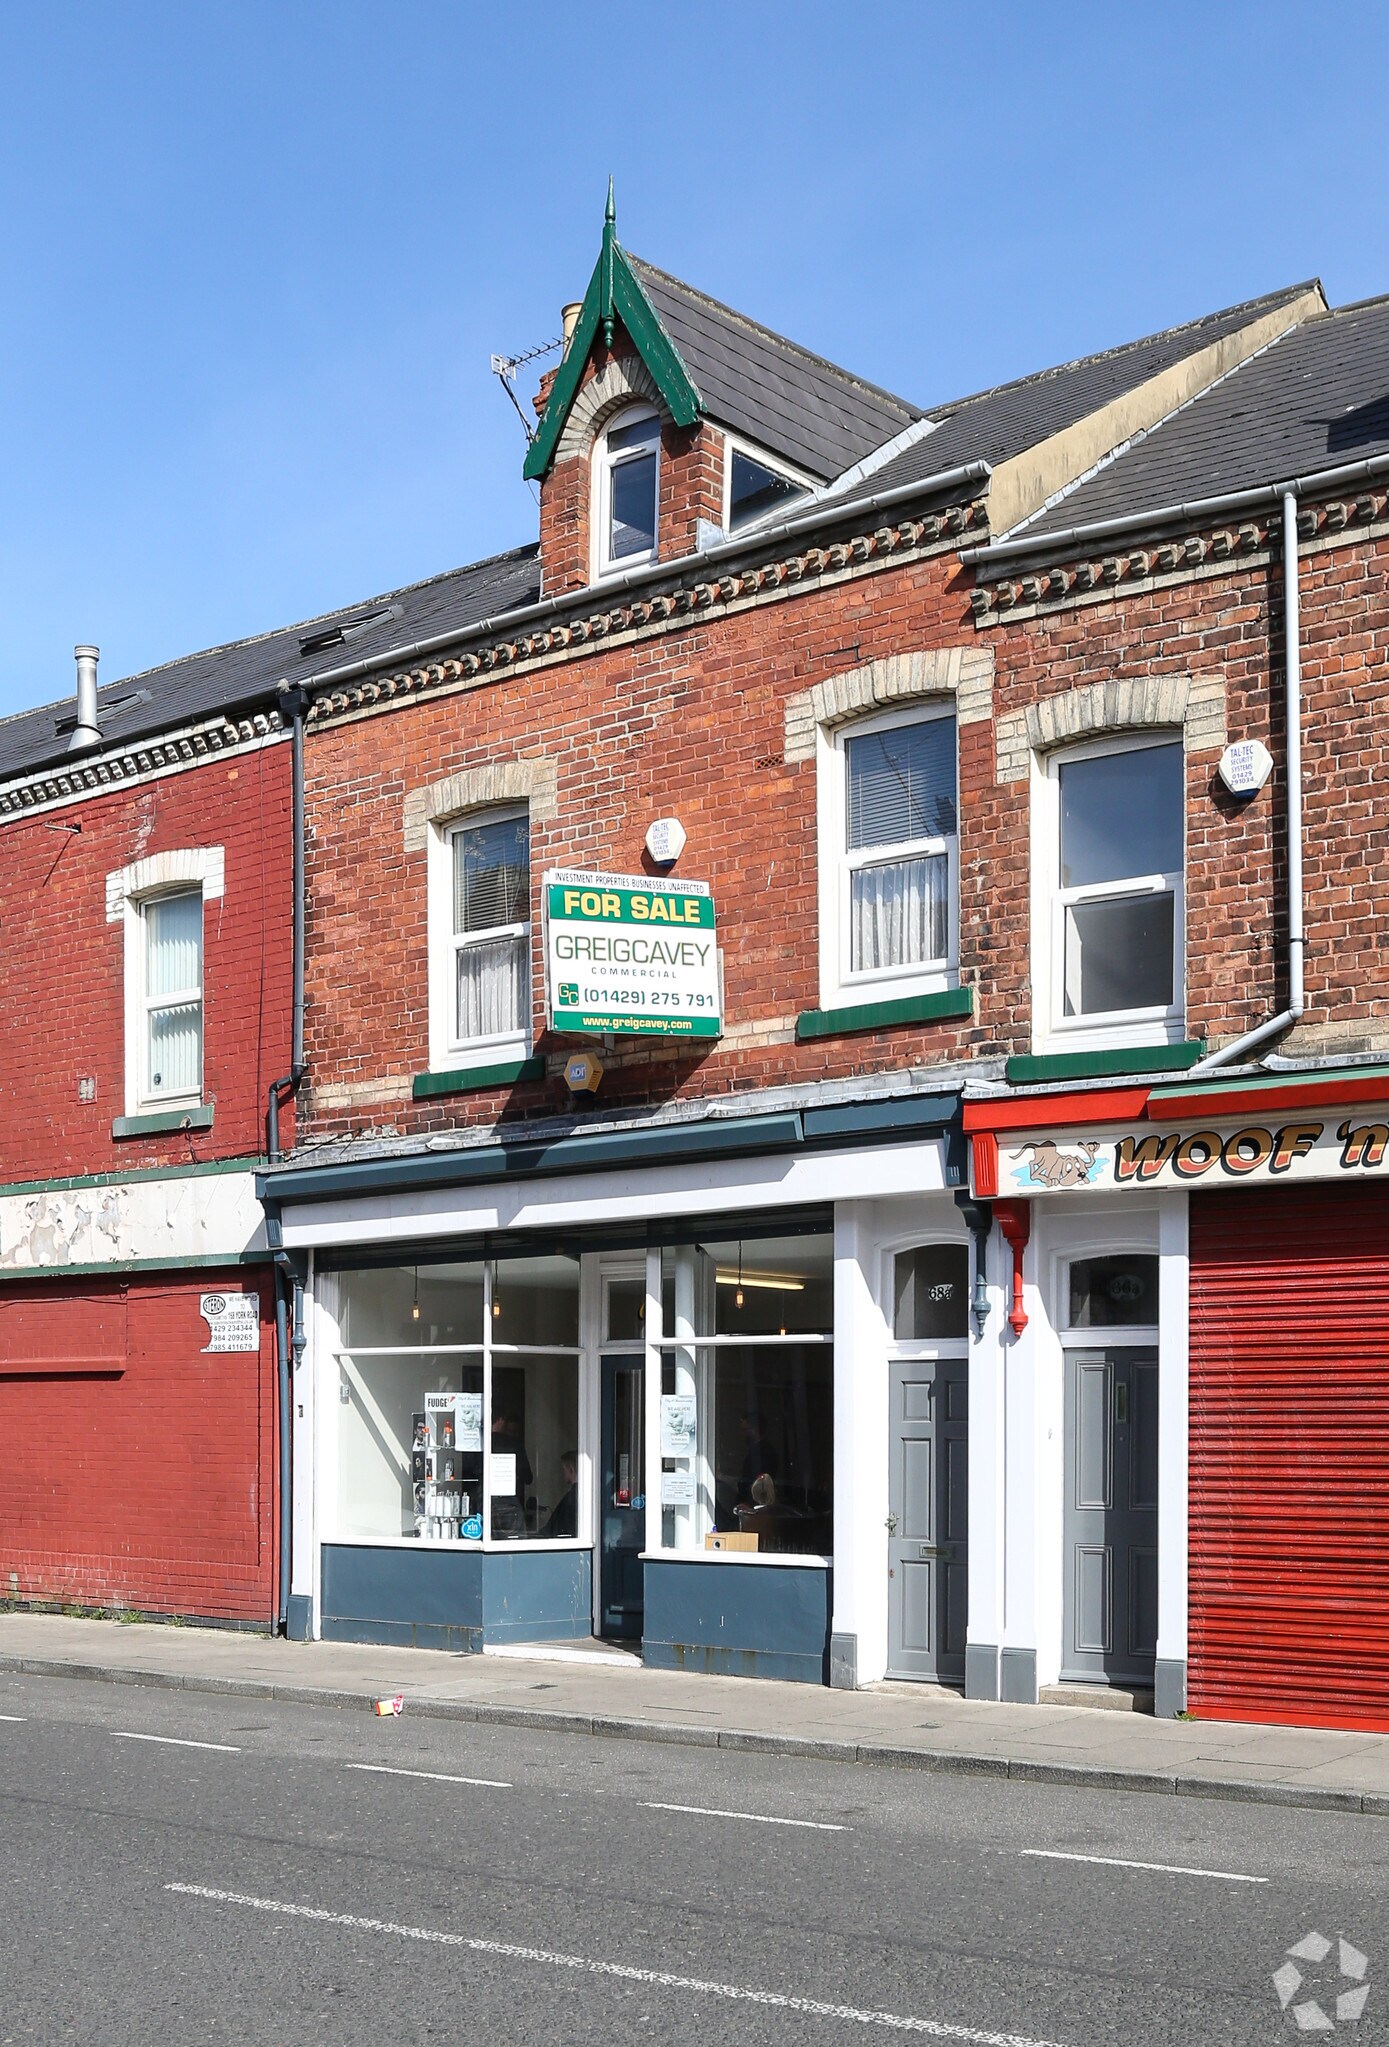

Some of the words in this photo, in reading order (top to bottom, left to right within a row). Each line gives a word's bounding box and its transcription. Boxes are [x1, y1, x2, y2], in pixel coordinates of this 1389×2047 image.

[1230, 756, 1253, 766] SECURITY
[1231, 764, 1253, 773] SYSTEMS
[1232, 771, 1252, 780] 01429
[555, 872, 594, 884] INVESTMENT
[596, 875, 630, 887] PROPERTIES
[632, 879, 666, 891] BUSINESSES
[668, 883, 705, 894] UNAFFECTED
[563, 890, 622, 918] FOR
[630, 895, 701, 923] SALE
[556, 934, 710, 966] GREIGCAVEY
[591, 966, 677, 979] COMMERCIAL
[584, 988, 645, 1005] (01429)
[651, 992, 680, 1006] 275
[686, 994, 713, 1007] 791
[582, 1016, 692, 1030] www.greigcavey.com
[1113, 1122, 1324, 1183] WOOF
[928, 1286, 951, 1299] 68a
[204, 1297, 224, 1312] STERON
[236, 1311, 247, 1319] YORK
[247, 1310, 258, 1319] ROAD
[427, 1398, 448, 1408] FUDGE
[466, 1521, 478, 1532] xln
